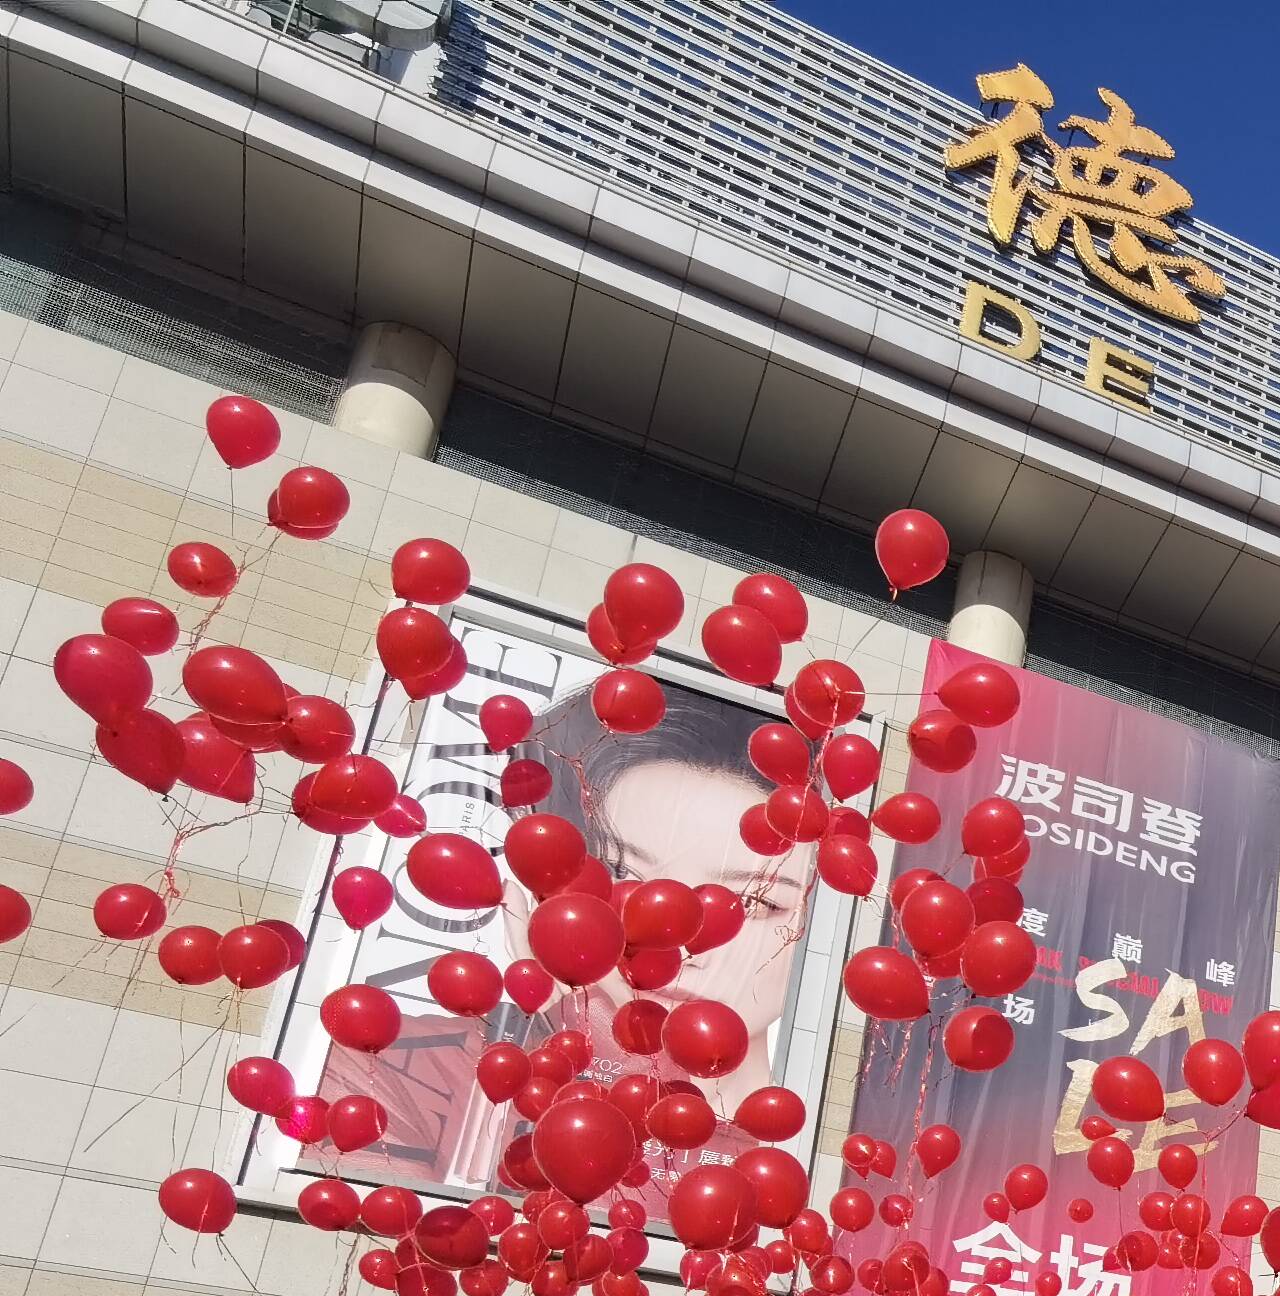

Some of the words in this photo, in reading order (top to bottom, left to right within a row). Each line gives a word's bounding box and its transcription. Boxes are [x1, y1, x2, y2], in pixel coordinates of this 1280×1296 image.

[959, 280, 1156, 415] DE
[994, 753, 1205, 858] 波司登
[1020, 813, 1197, 885] OSIDENG
